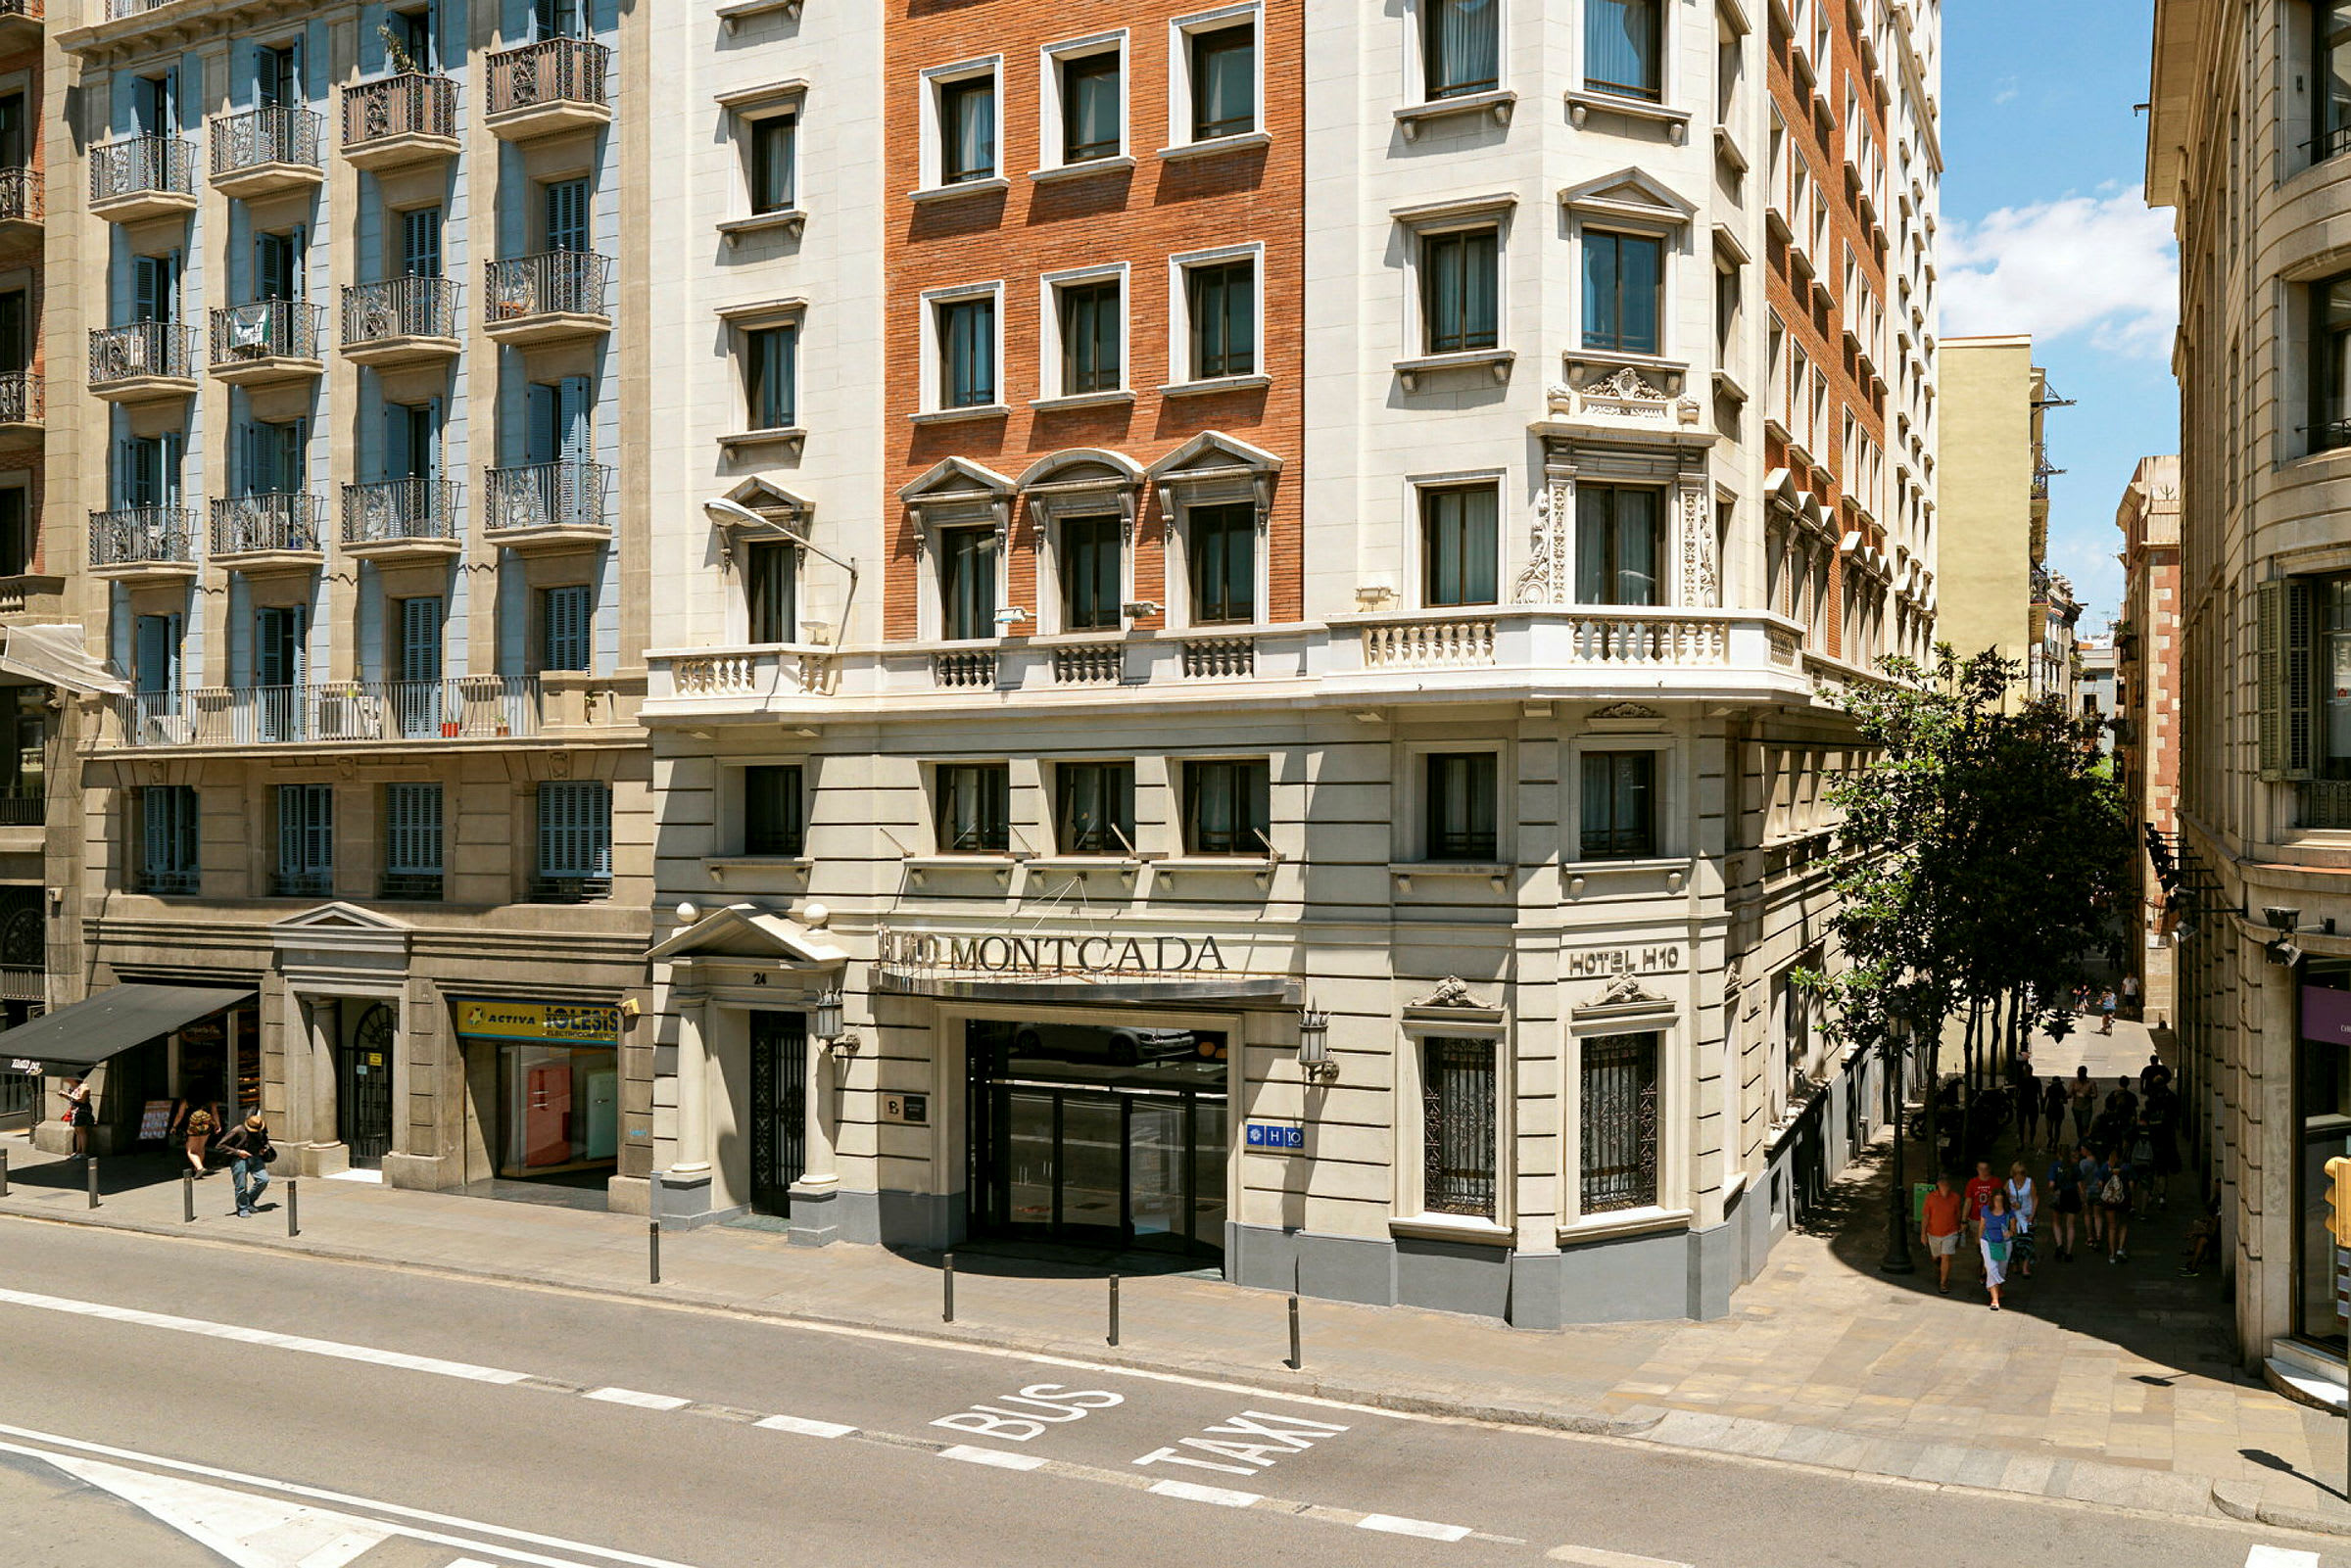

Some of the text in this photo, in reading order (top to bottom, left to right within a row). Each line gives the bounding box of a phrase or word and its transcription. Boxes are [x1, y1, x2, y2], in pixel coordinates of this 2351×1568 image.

[949, 935, 1228, 973] MONTCADA
[1569, 946, 1679, 976] HOTEL H10
[753, 973, 767, 985] 24
[488, 1015, 536, 1025] ACTIVA
[929, 1383, 1125, 1442] BUS
[1131, 1410, 1351, 1475] TAXI
